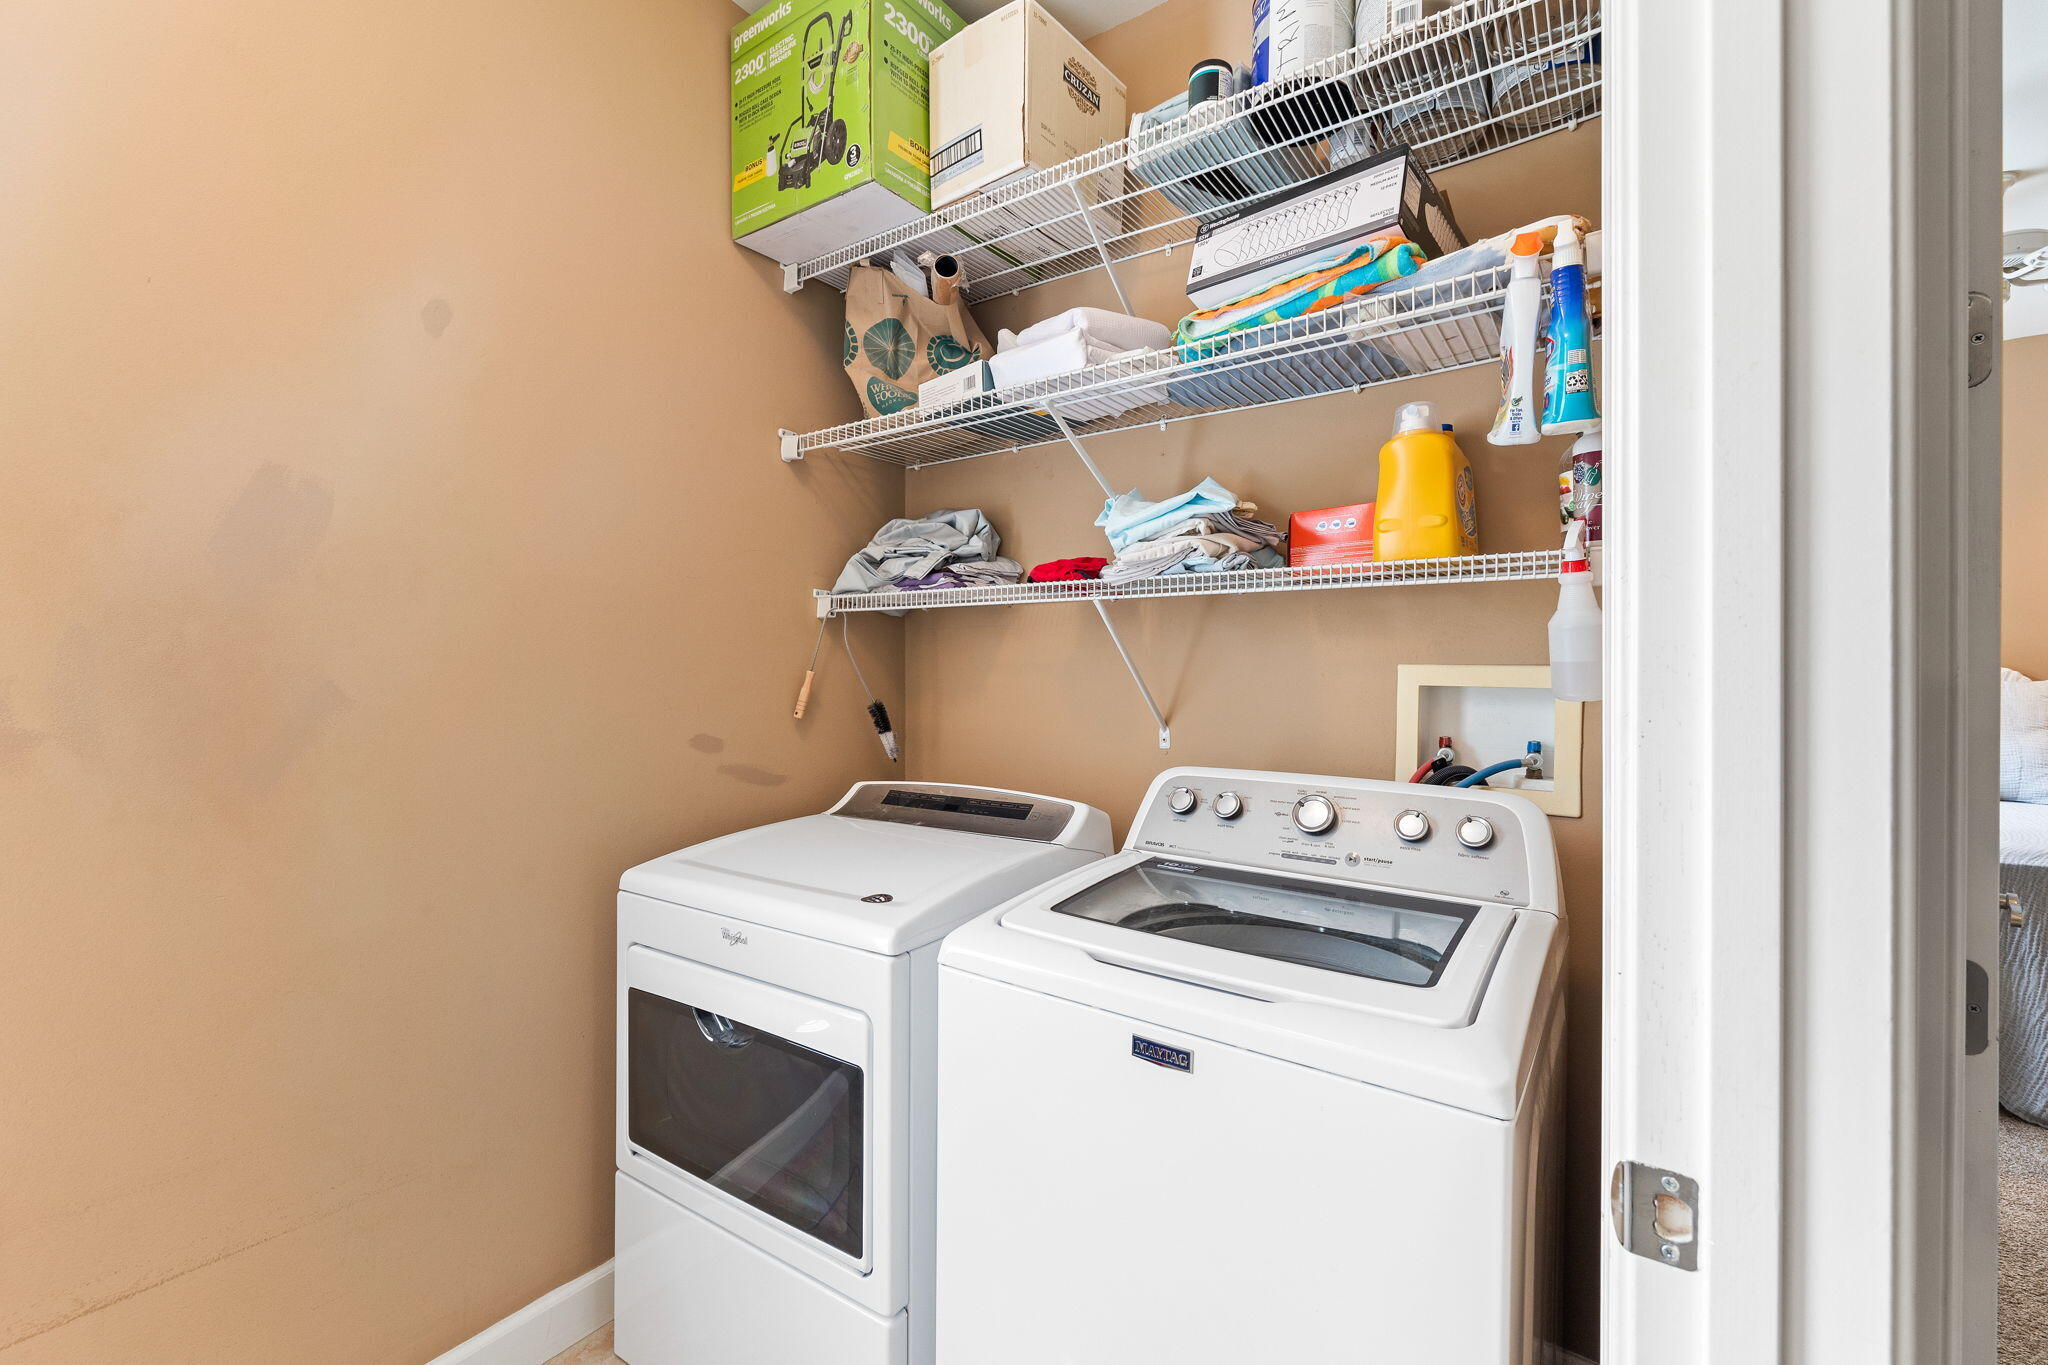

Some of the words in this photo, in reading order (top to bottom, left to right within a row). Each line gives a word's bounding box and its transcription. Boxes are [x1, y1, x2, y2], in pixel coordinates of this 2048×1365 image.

[734, 1, 792, 54] greenworks
[884, 2, 930, 53] 2300
[734, 53, 764, 85] 2300
[1064, 69, 1100, 107] CRUZAN
[850, 146, 857, 158] 3
[909, 139, 930, 157] BONU
[745, 158, 763, 171] BONUS
[1259, 252, 1287, 265] COMMERCIAL
[1287, 246, 1306, 256] SERVICE
[721, 927, 749, 947] Whirlpool
[1134, 1040, 1189, 1067] MAYTAG
